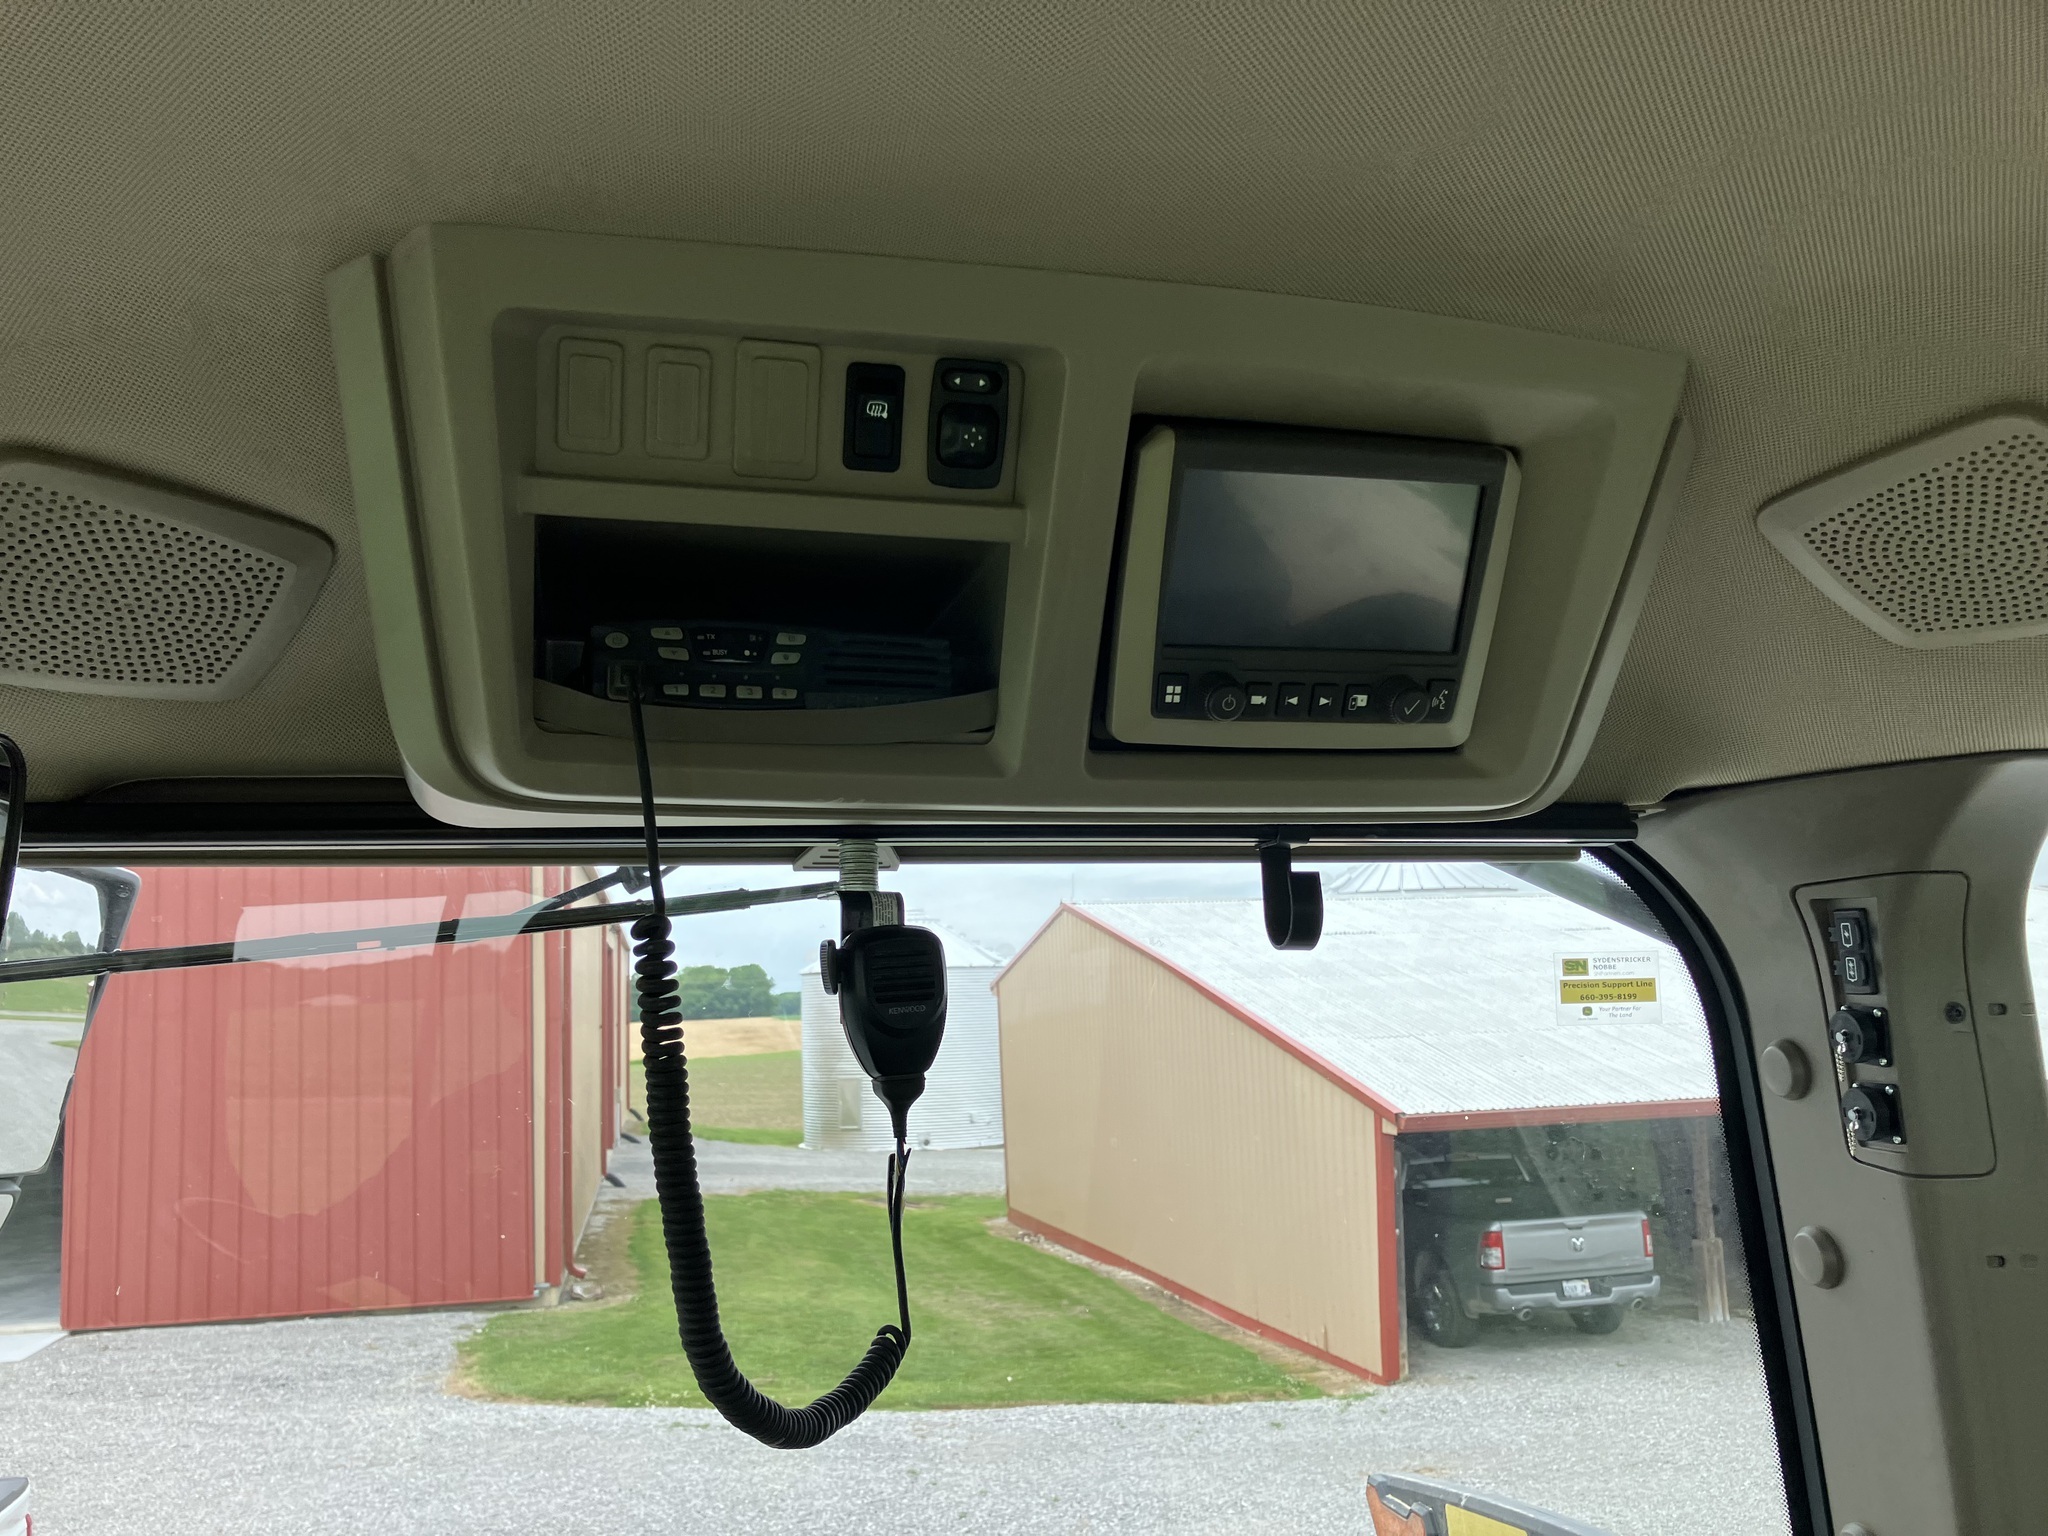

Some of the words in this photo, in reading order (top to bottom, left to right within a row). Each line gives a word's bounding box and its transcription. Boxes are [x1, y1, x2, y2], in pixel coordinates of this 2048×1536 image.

[1602, 981, 1634, 989] Support
[1580, 993, 1637, 1001] 660-395-8199
[888, 1004, 926, 1015] KENWOOD
